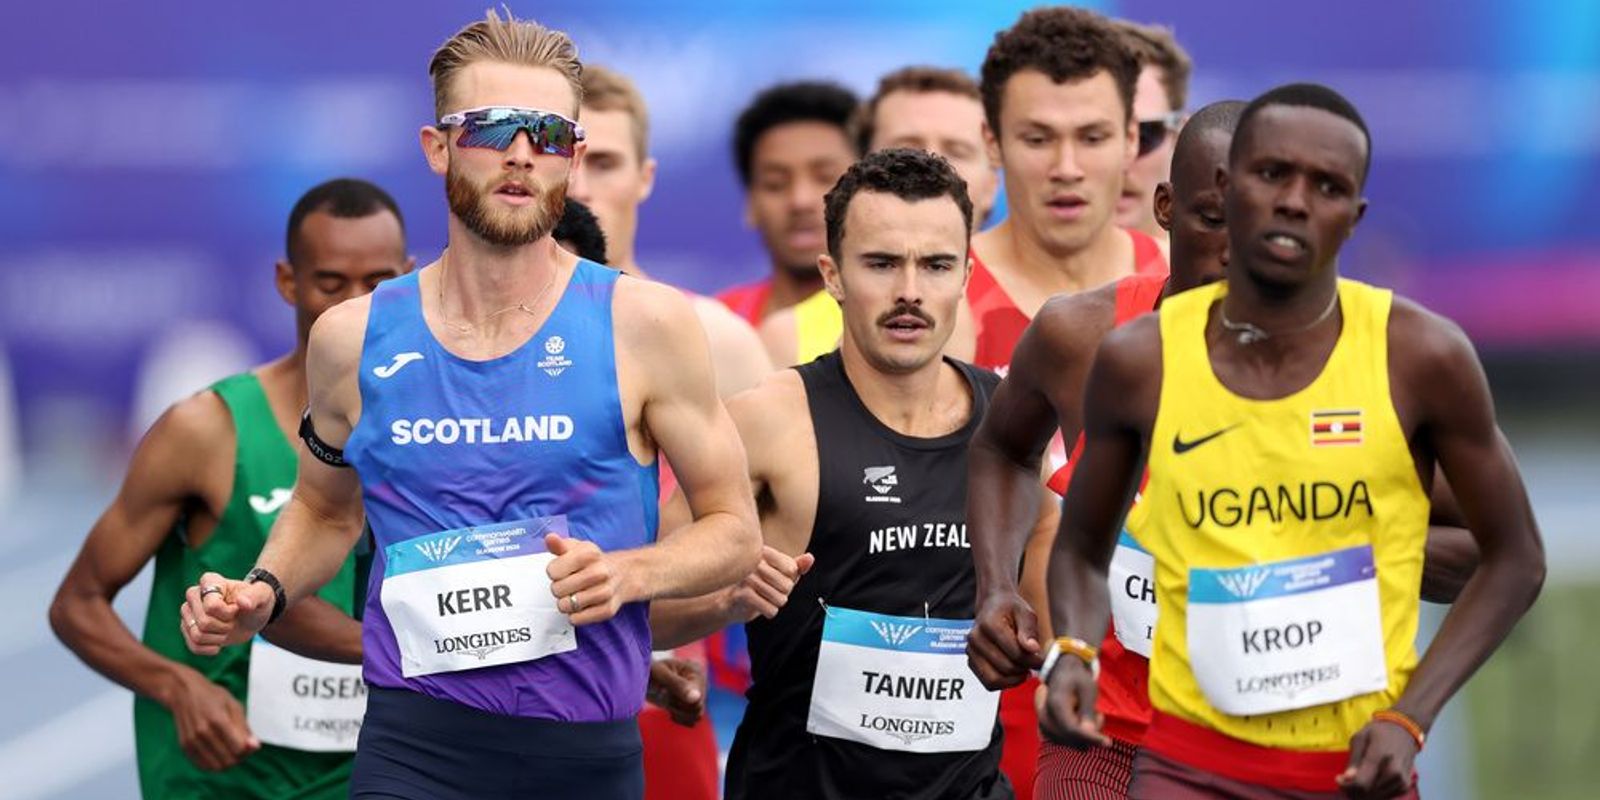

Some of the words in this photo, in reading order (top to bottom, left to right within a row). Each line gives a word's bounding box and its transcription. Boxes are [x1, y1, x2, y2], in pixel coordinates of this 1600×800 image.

[391, 415, 575, 445] SCOTLAND
[1176, 480, 1374, 529] UGANDA
[869, 525, 917, 554] NEW
[923, 523, 971, 549] ZEAL
[437, 584, 513, 616] KERR
[434, 627, 532, 654] LONGINES
[1242, 620, 1323, 654] KROP
[862, 670, 965, 701] TANNER
[860, 714, 955, 735] LONGINES
